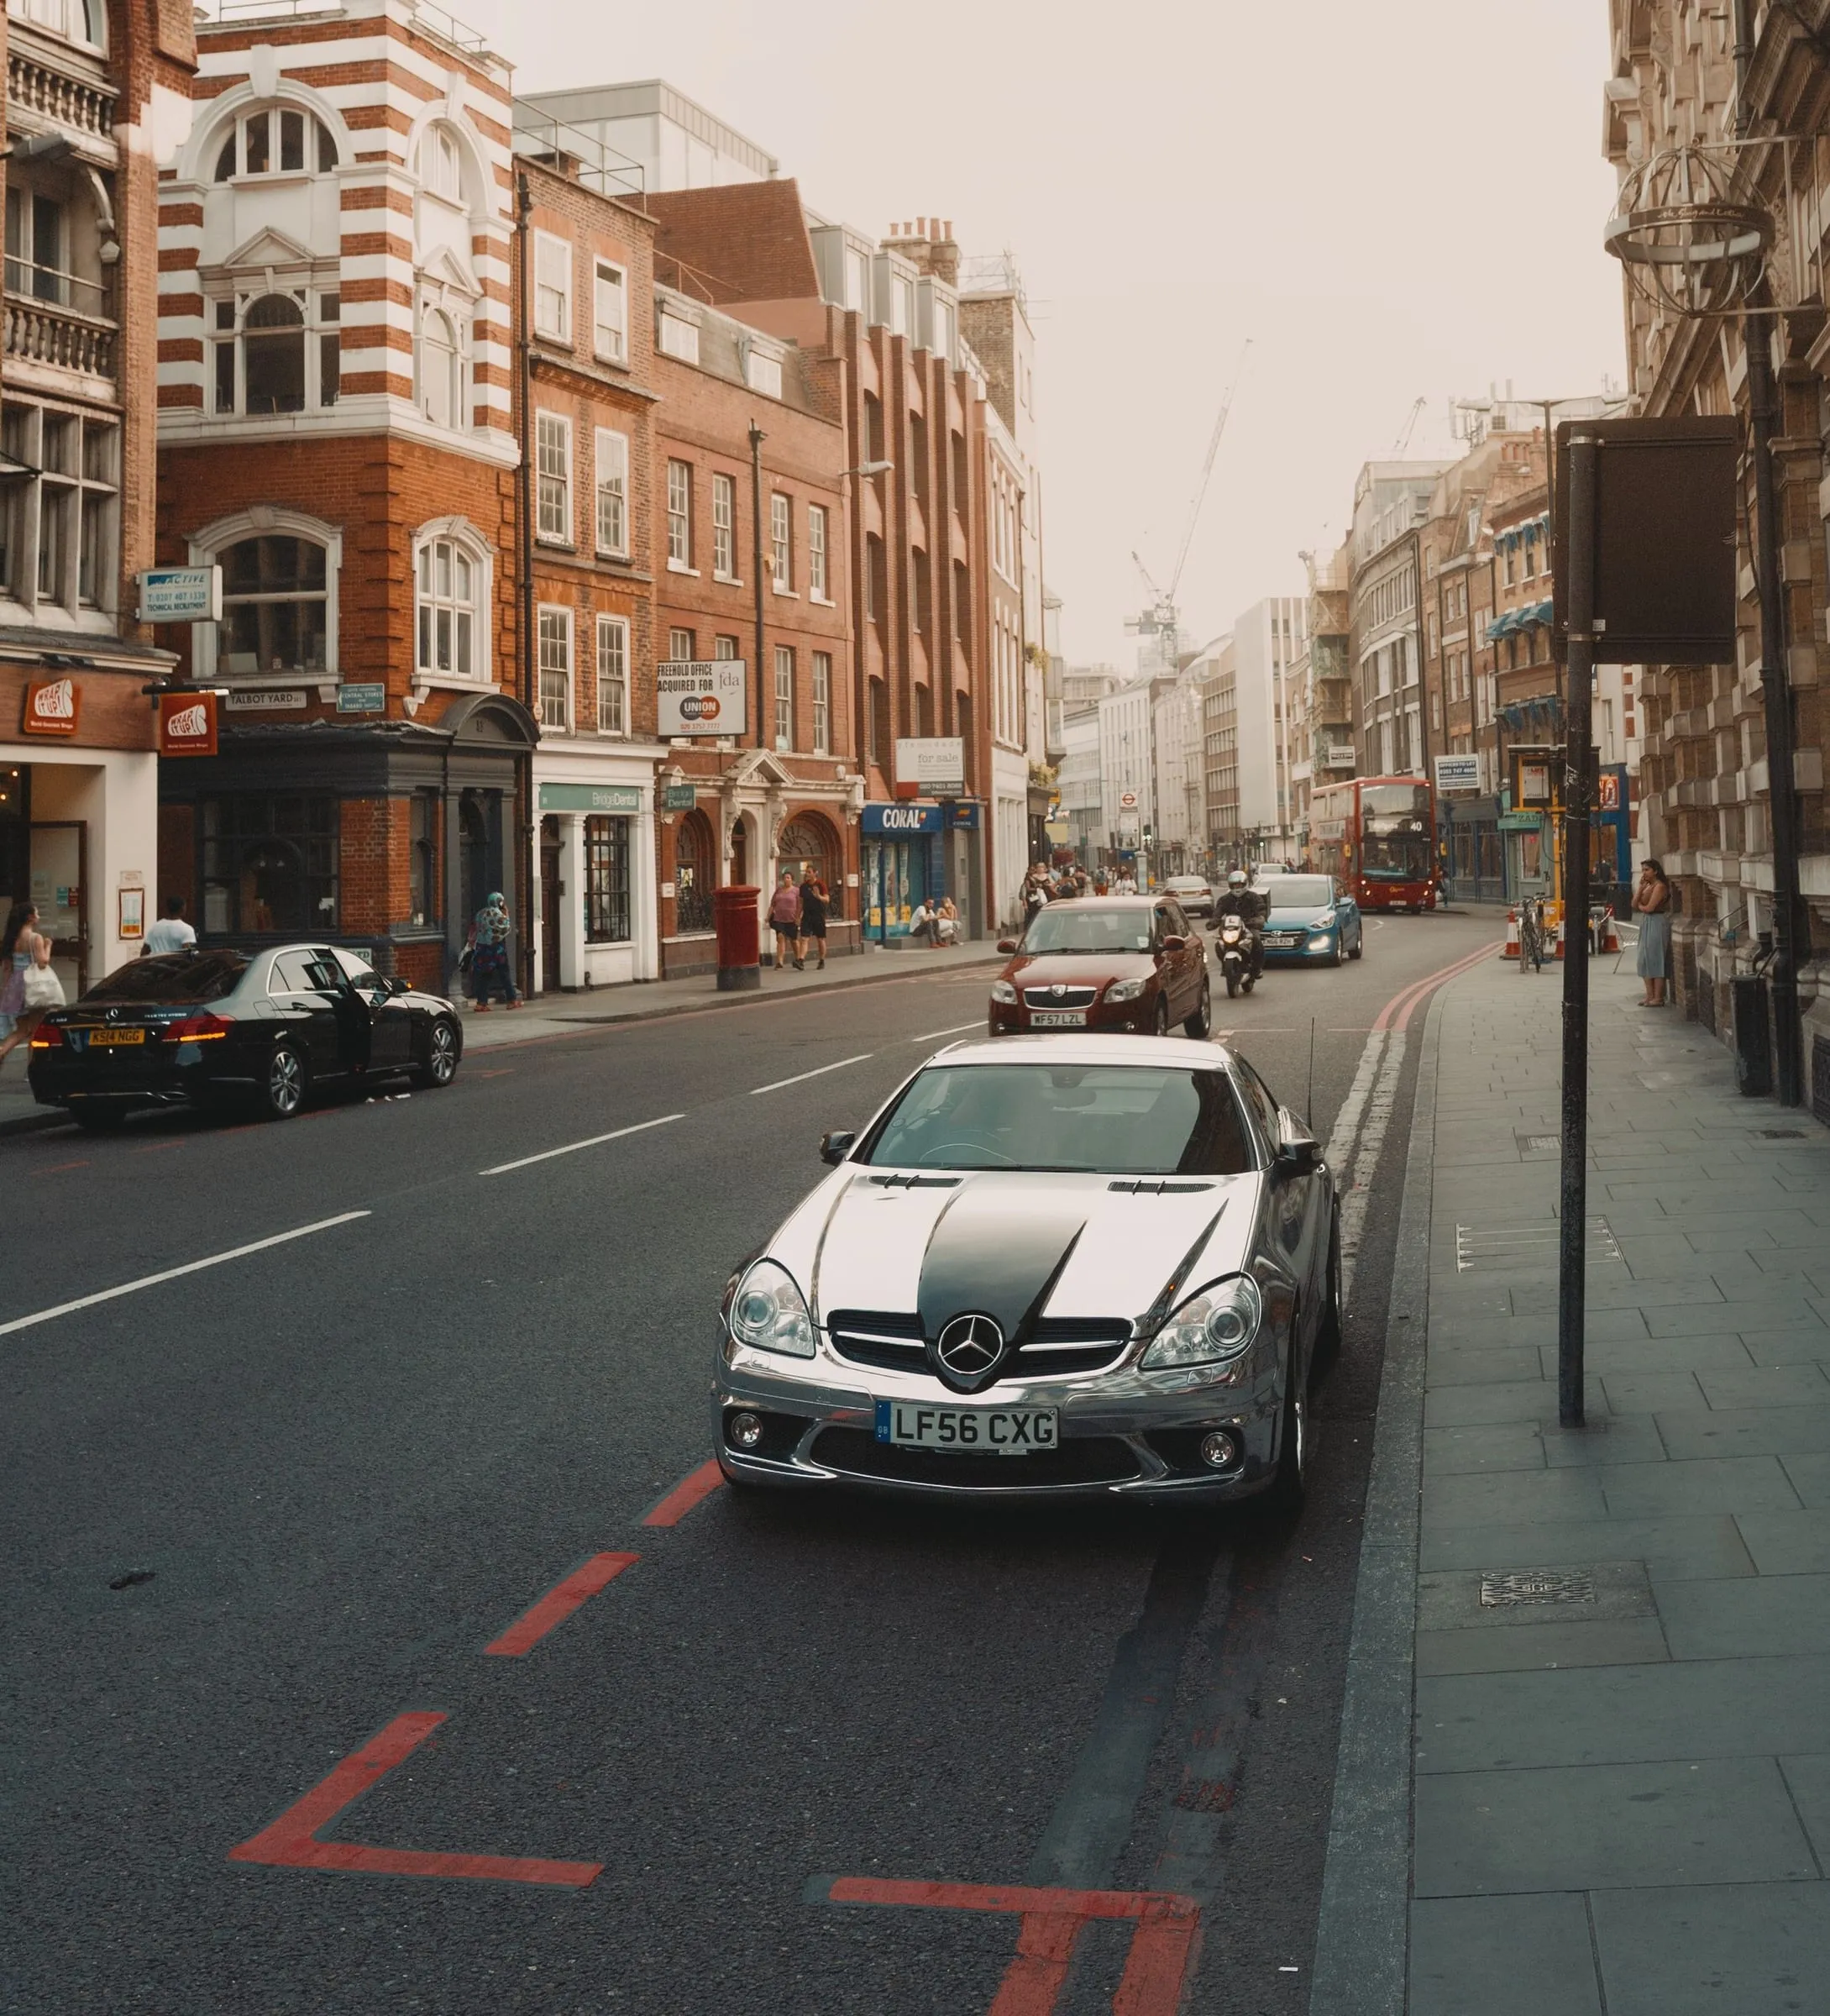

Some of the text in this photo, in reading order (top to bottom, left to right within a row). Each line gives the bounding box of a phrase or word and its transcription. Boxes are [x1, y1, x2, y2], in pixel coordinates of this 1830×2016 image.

[148, 601, 207, 612] TECHNICAL RECRUITMENT
[658, 664, 712, 676] FREEHOLD OFFICE
[720, 672, 739, 689] fda
[658, 680, 713, 693] ACQUIRED FOR
[39, 685, 61, 701] WRAP
[231, 694, 265, 704] TALBOT
[269, 693, 292, 702] YARD
[38, 702, 46, 713] IT
[684, 701, 716, 712] UNION
[170, 710, 193, 724] WRAP
[170, 725, 179, 734] IT
[918, 753, 959, 763] for sale
[883, 808, 920, 828] CORAL
[1411, 822, 1423, 832] 40
[1062, 1015, 1082, 1024] LZL
[92, 1028, 141, 1043] KS14 NGG
[896, 1409, 1053, 1444] LF56 CXG
